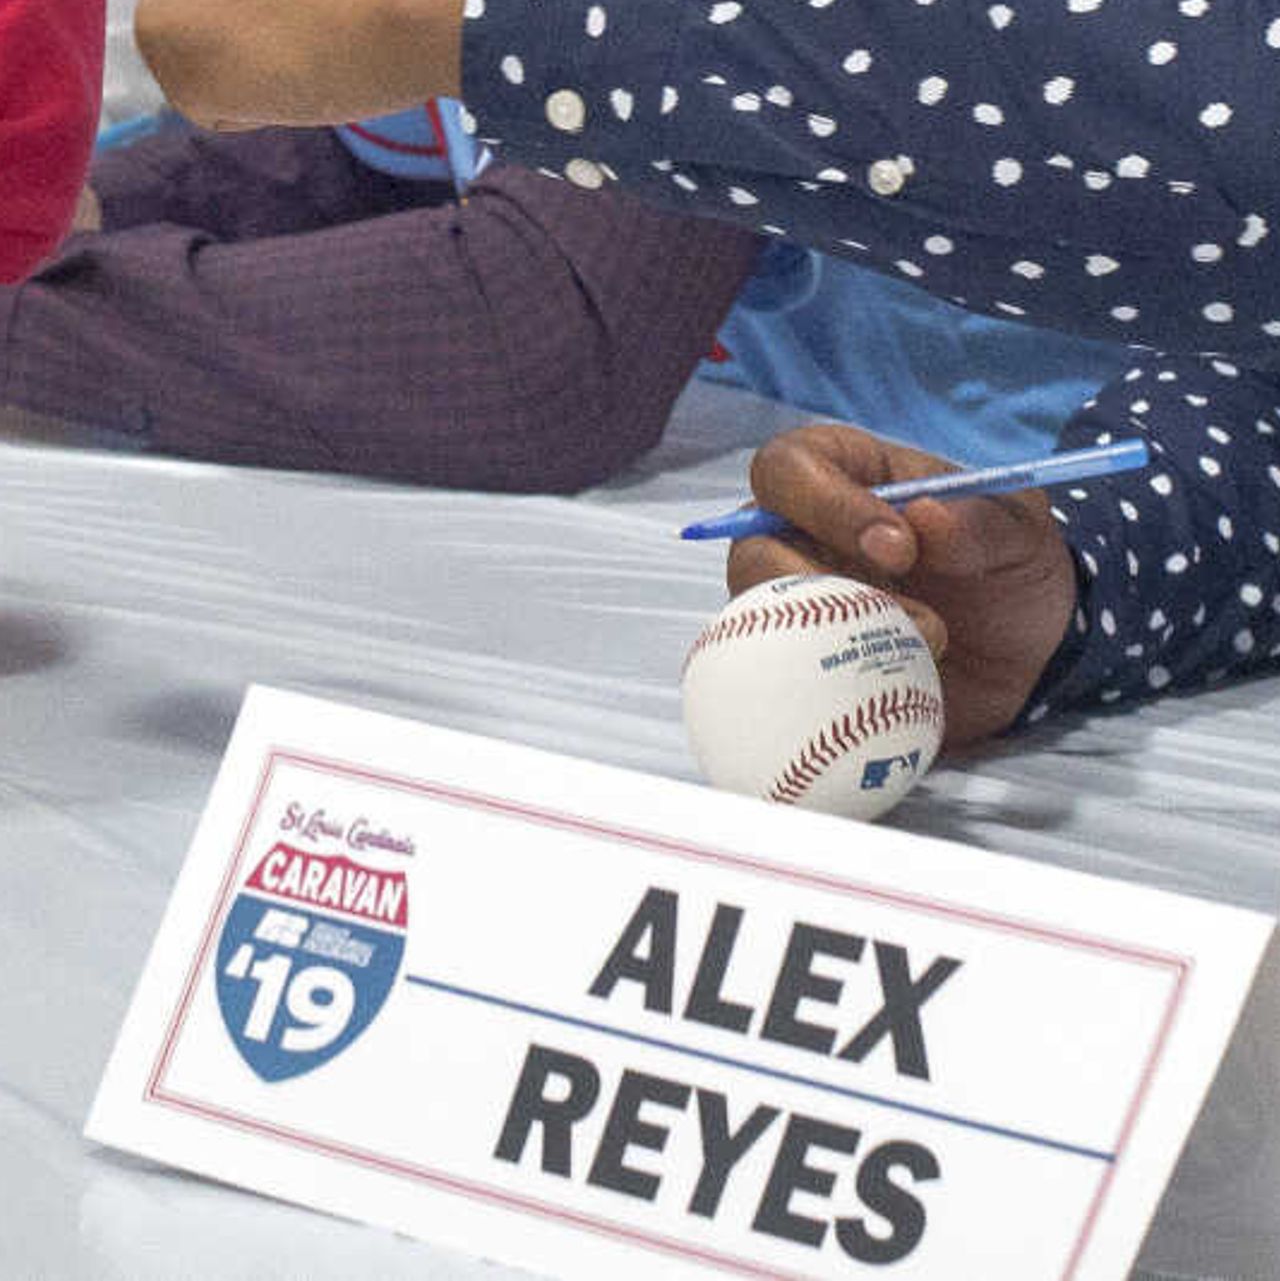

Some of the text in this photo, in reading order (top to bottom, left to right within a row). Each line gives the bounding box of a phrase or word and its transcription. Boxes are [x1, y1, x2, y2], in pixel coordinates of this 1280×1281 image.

[260, 847, 406, 928] CARAVAN
[586, 885, 966, 1083] ALEX
[492, 1042, 941, 1265] REYES
